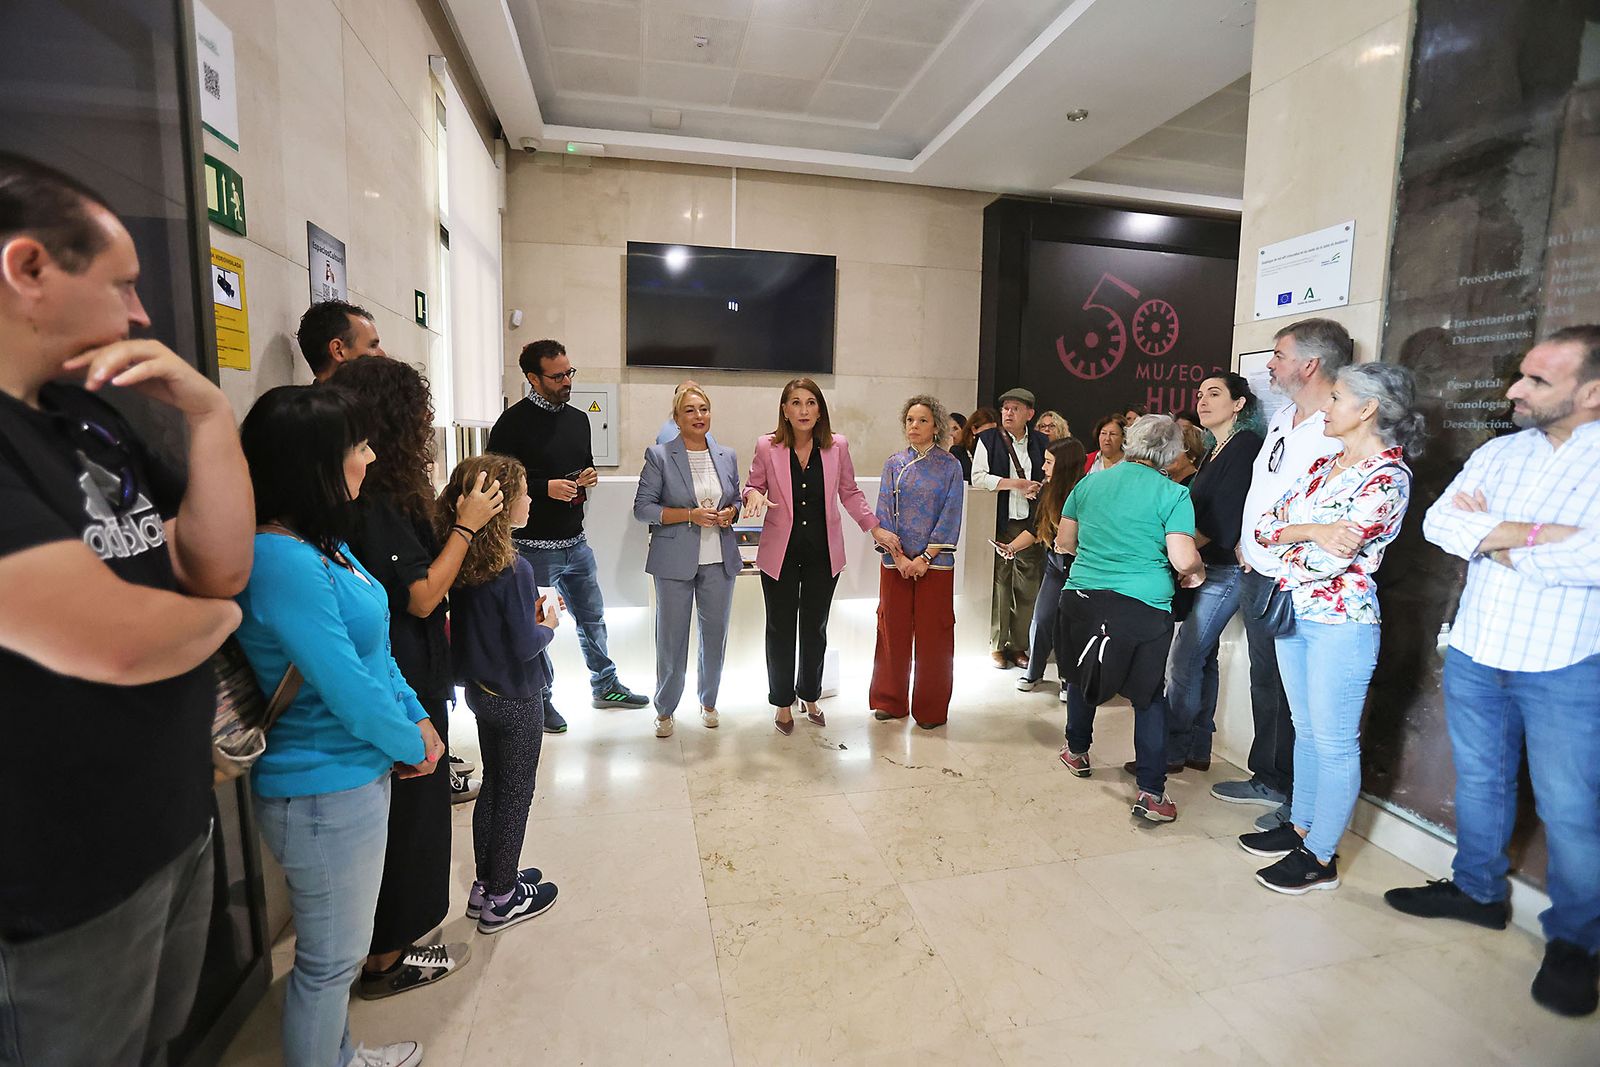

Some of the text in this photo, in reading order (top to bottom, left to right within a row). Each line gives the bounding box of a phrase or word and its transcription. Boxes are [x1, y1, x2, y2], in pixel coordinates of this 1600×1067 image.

[1459, 267, 1534, 286] Procedencia:
[1454, 313, 1514, 329] Inventario
[1452, 331, 1533, 345] Dimensiones:
[1136, 363, 1204, 382] MUSEO
[1447, 378, 1504, 390] Peso total:
[1443, 418, 1513, 431] Descripción:
